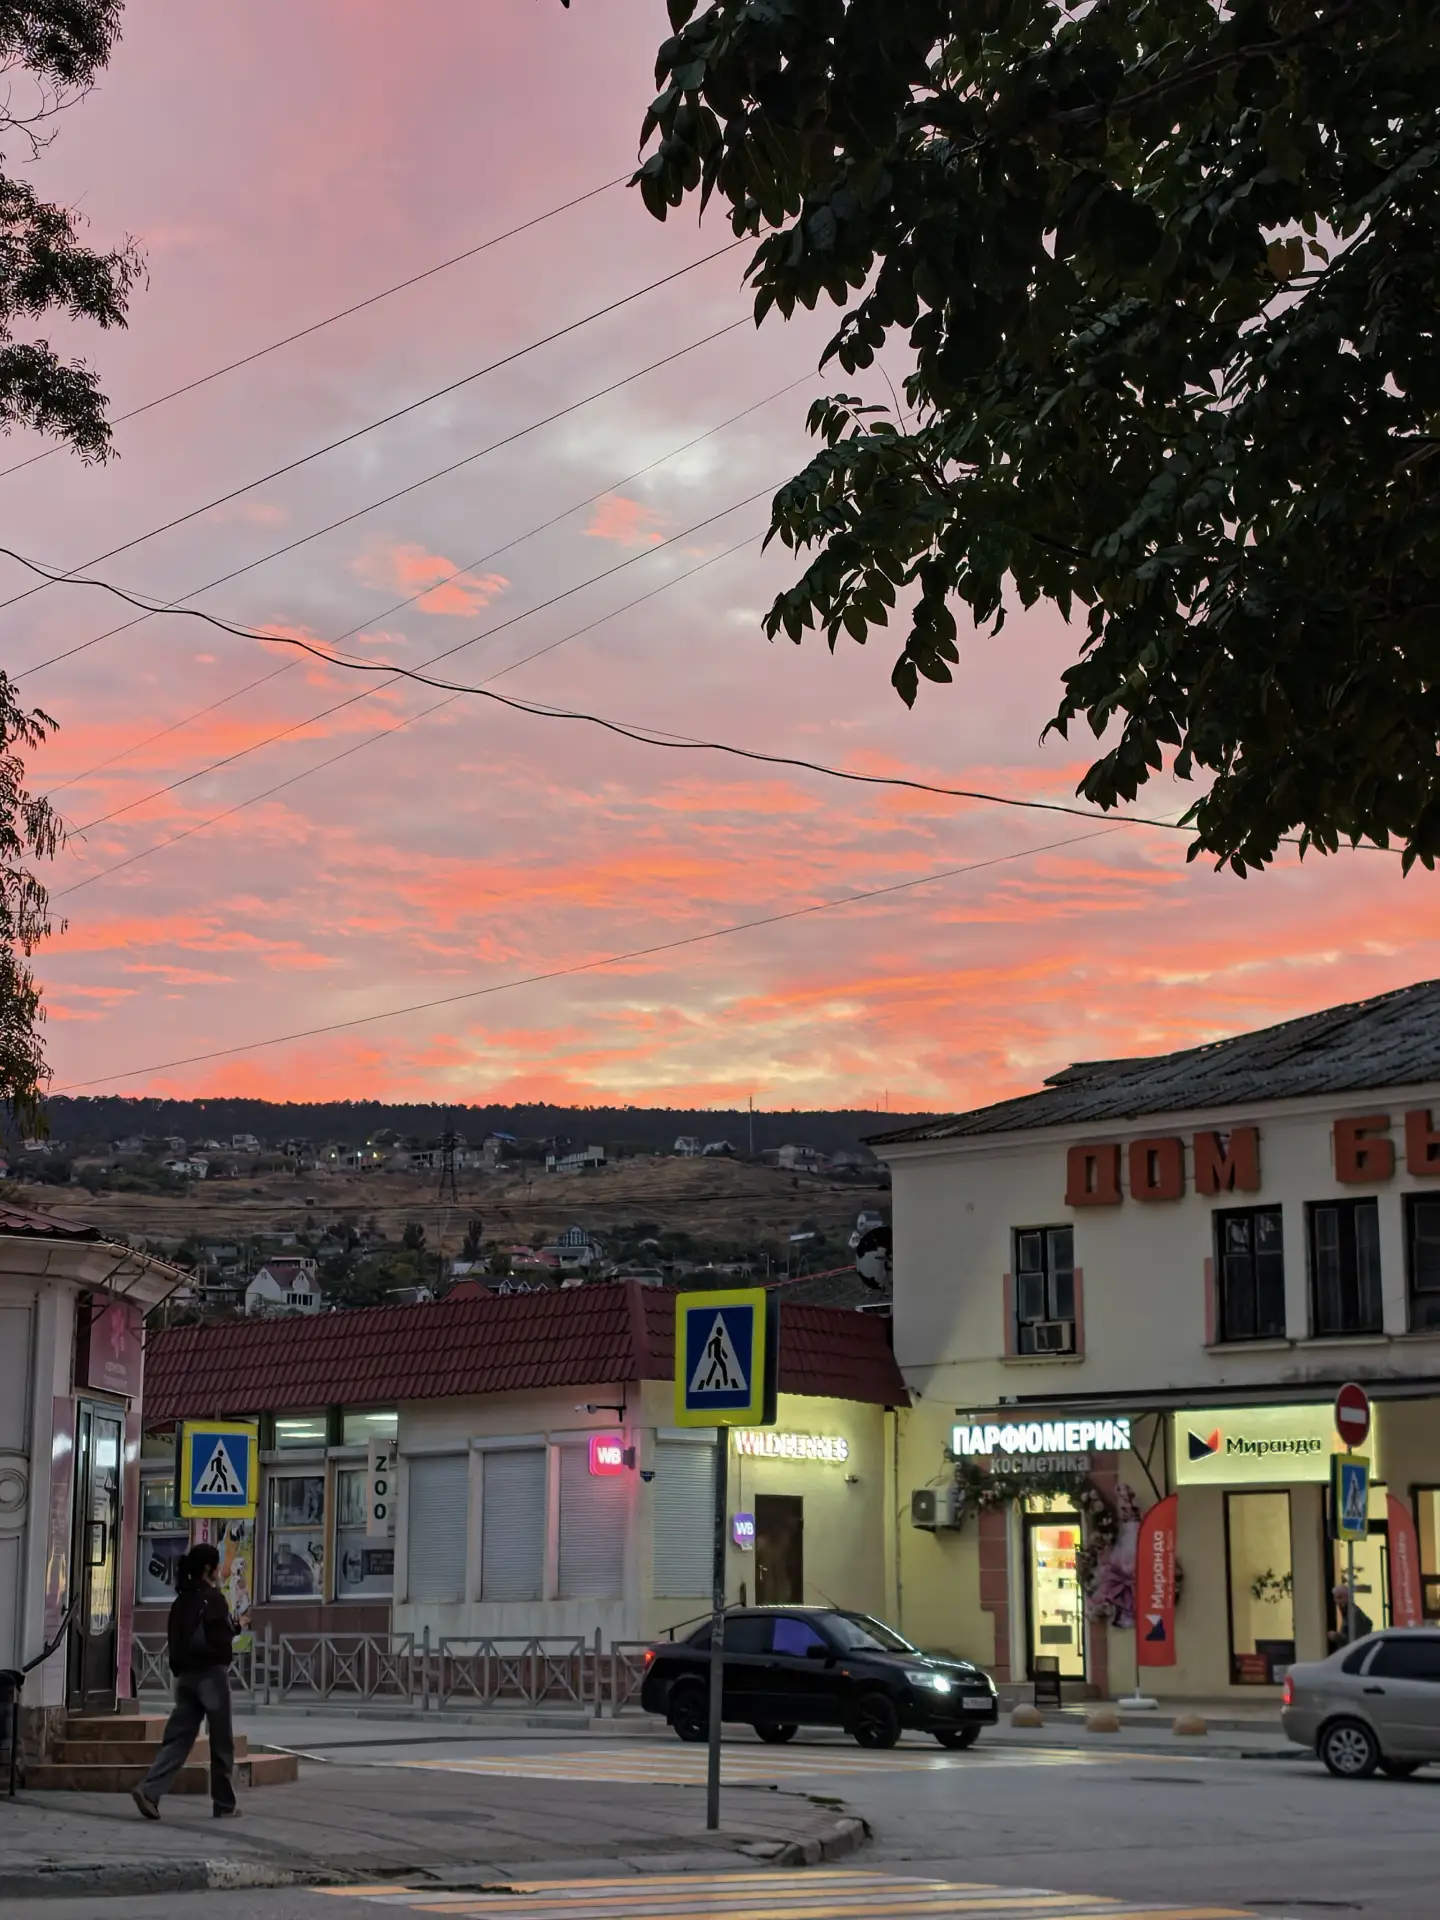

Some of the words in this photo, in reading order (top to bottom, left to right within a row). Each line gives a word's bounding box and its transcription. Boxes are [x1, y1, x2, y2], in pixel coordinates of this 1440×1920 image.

[1065, 1127, 1261, 1207] ДОМ
[953, 1419, 1130, 1455] ПАРФЮМЕРИЯ
[1226, 1437, 1321, 1457] Миранда
[596, 1447, 622, 1464] WB
[991, 1456, 1090, 1474] косметика
[374, 1456, 387, 1519] ZOO
[735, 1522, 754, 1535] WB
[1151, 1530, 1166, 1609] Миранда
